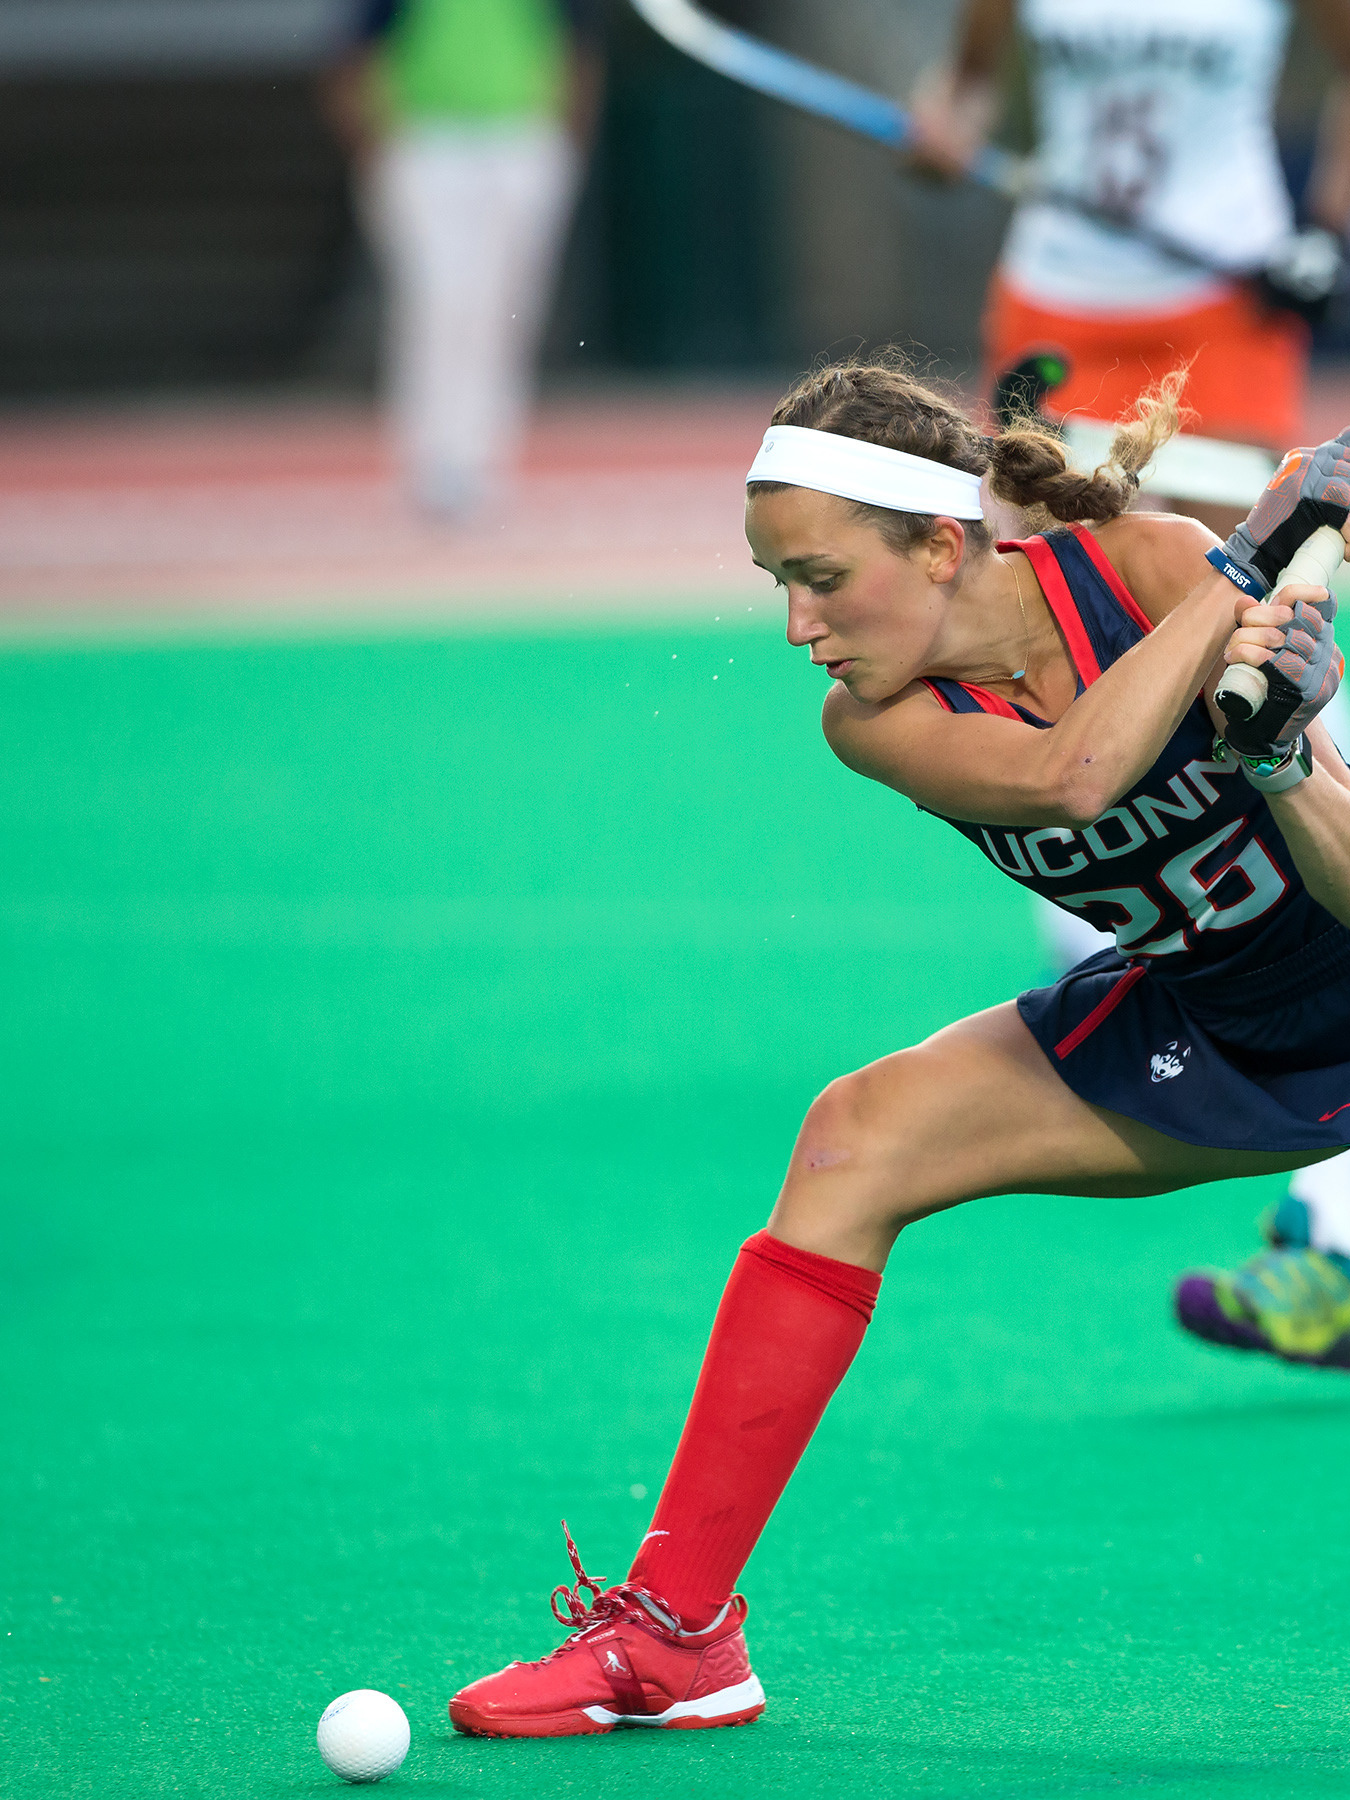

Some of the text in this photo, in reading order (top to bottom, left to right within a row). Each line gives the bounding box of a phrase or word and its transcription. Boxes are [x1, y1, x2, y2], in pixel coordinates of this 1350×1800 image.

[1223, 563, 1251, 588] TRUST
[980, 758, 1241, 878] UCONN
[1054, 814, 1291, 958] 26
